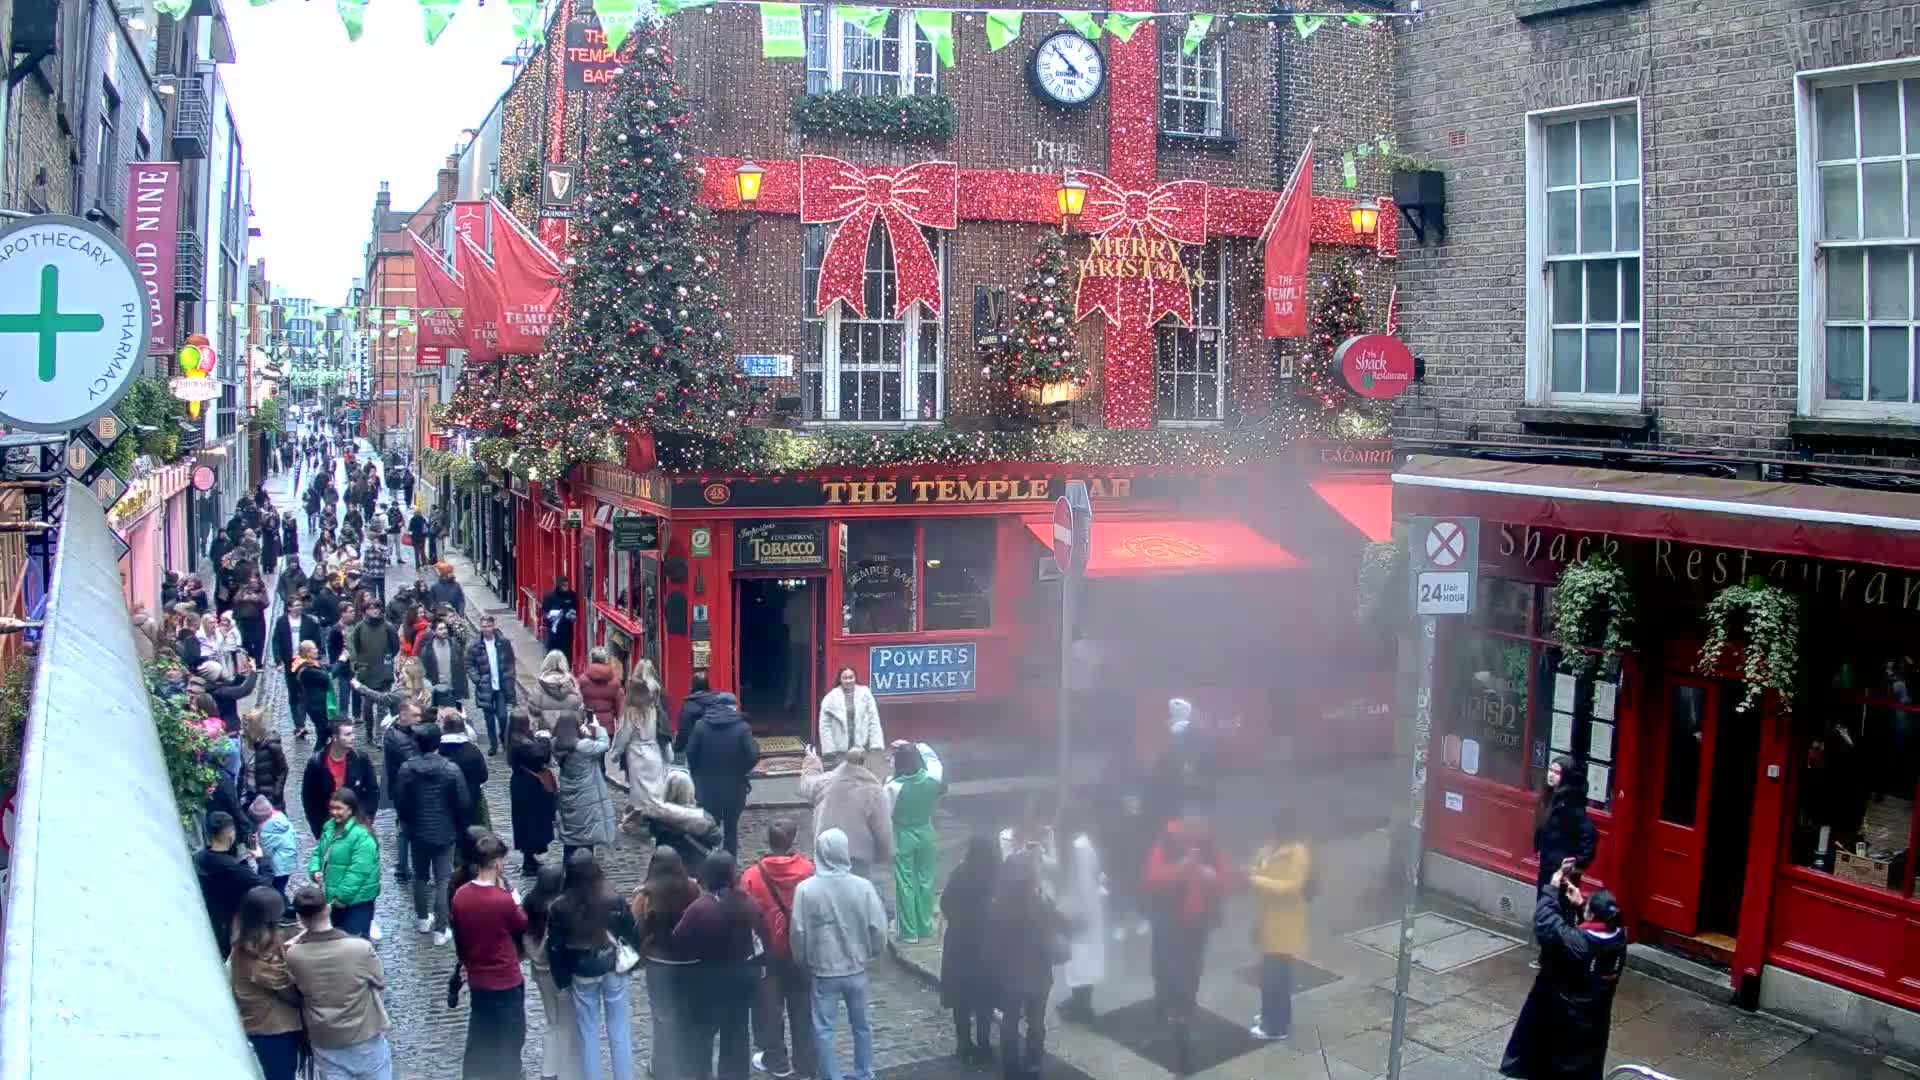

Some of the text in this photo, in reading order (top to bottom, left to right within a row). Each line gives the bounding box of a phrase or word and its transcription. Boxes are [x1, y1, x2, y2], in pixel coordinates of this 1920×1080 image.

[567, 47, 631, 64] TEMPLE
[135, 171, 169, 232] NINE
[1089, 237, 1184, 261] MERRY
[1279, 275, 1293, 286] THE
[522, 303, 547, 313] THE
[1274, 302, 1295, 313] BAR
[433, 327, 458, 336] BAR
[88, 303, 136, 401] PHARMACY
[1355, 349, 1388, 375] Shack
[1372, 371, 1409, 380] Restaurant
[635, 477, 652, 499] BAR
[823, 481, 897, 504] THE
[912, 479, 1049, 502] TEMPLE
[750, 538, 815, 561] TOBACCO
[1498, 522, 1620, 567] Shack
[847, 565, 913, 588] TEMPLE BAR
[1420, 583, 1443, 603] 24
[1443, 593, 1465, 602] HOUR
[879, 647, 969, 667] POWER'S
[872, 669, 972, 690] WHISKEY
